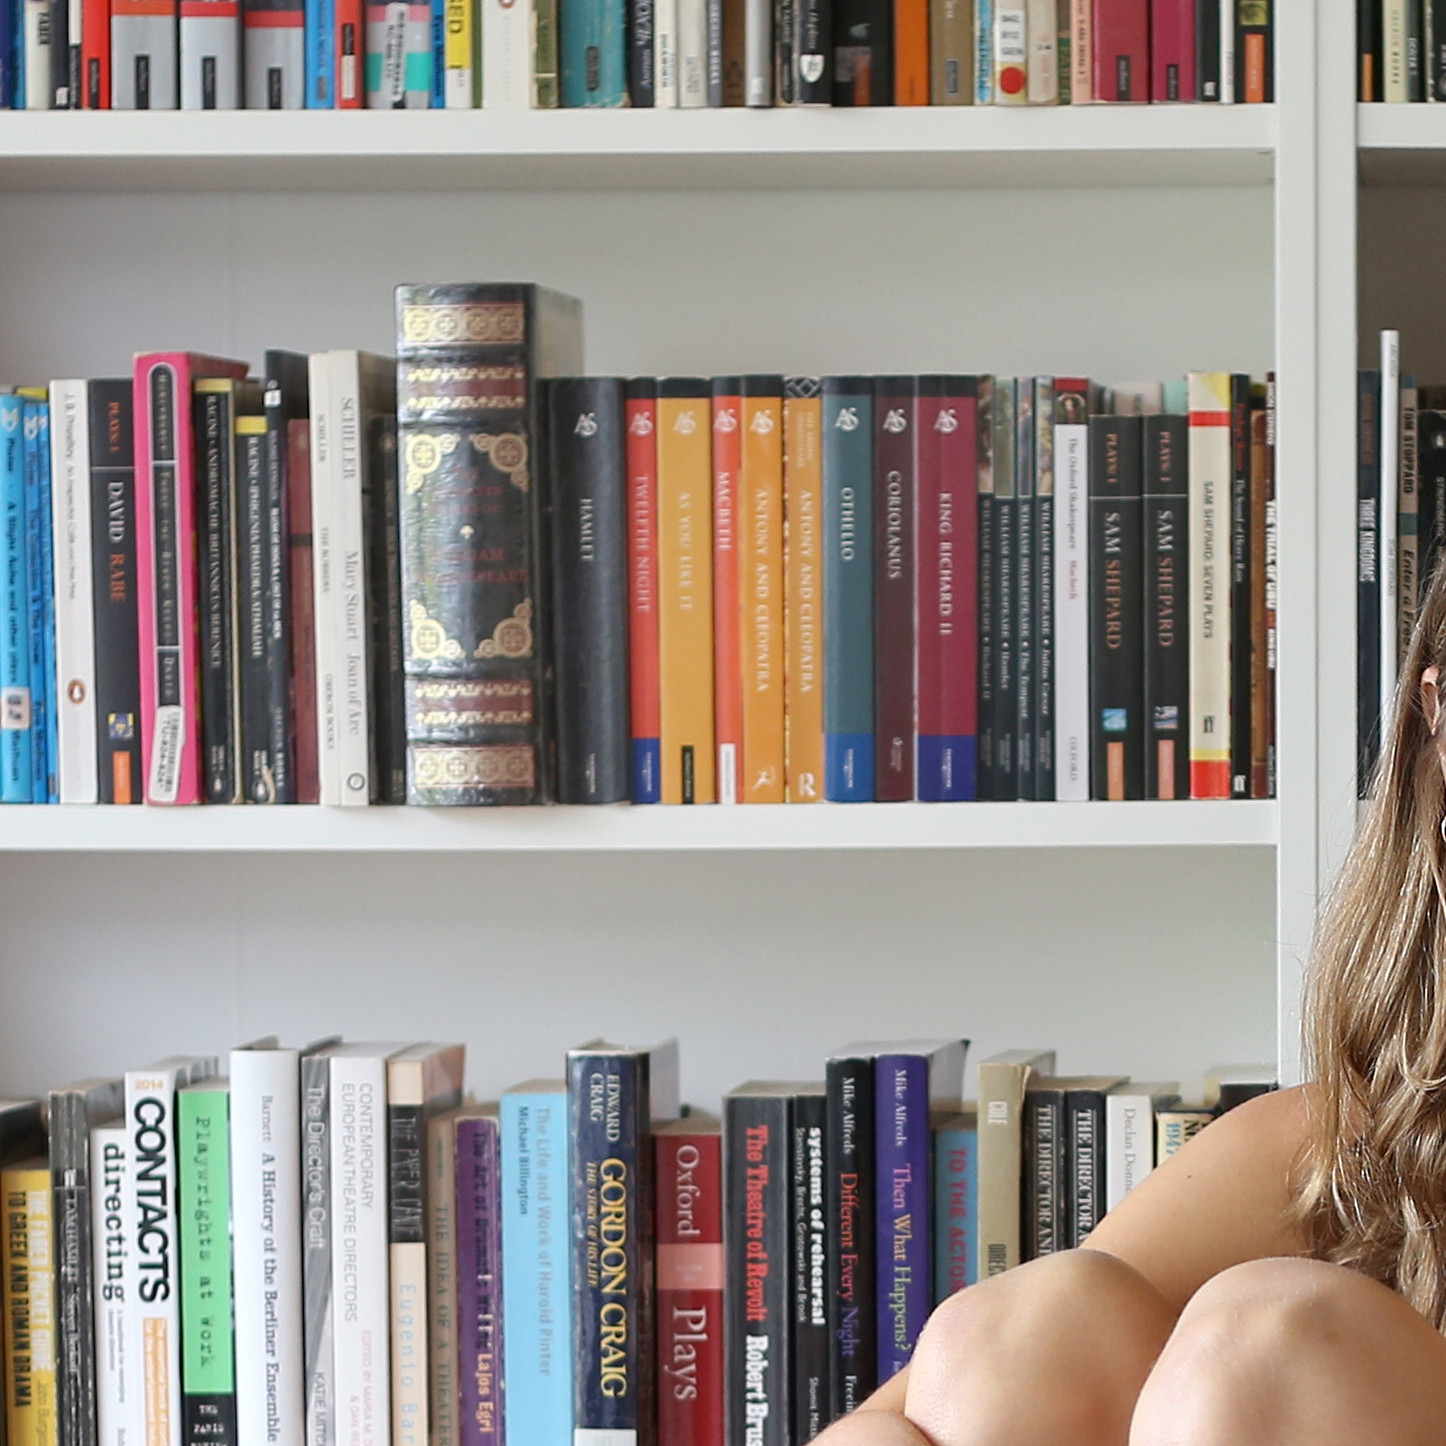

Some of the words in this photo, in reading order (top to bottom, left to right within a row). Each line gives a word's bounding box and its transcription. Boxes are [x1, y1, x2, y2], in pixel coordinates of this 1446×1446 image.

[341, 397, 356, 480] SCHILLER
[1403, 407, 1414, 432] TOM
[1403, 435, 1415, 494] STOPPARD
[108, 482, 124, 543] DAVID
[579, 498, 594, 562] HAMLET
[635, 474, 649, 551] TWELFTH
[717, 471, 731, 551] MACBETH
[755, 488, 769, 556] ANTONY
[840, 487, 855, 560] OTHELLO
[887, 470, 902, 579] CORIOLANUS
[938, 493, 952, 534] KING
[1157, 510, 1173, 551] SAM
[110, 553, 125, 603] RABE
[343, 551, 359, 591] Mary
[636, 556, 651, 613] NIGHT
[755, 562, 769, 598] AND
[938, 541, 952, 616] RICHARD
[346, 594, 360, 641] Stuart
[938, 622, 952, 635] II
[1157, 557, 1174, 647] SHEPARD
[347, 652, 360, 685] Joan
[755, 602, 770, 692] CLEOPATRA
[347, 687, 361, 705] of
[349, 707, 361, 735] Arc
[308, 1084, 325, 1117] The
[589, 1072, 604, 1122] CRAIG
[606, 1073, 620, 1142] EDWARD
[263, 1153, 276, 1164] A
[308, 1121, 325, 1202] Director's
[746, 1125, 767, 1161] The
[134, 1098, 169, 1303] CONTACTS
[195, 1116, 213, 1261] Playwrights
[260, 1170, 278, 1232] History
[676, 1144, 700, 1236] Oxford
[747, 1164, 767, 1237] Theatre
[839, 1172, 858, 1248] Different
[892, 1164, 910, 1209] Then
[101, 1144, 128, 1303] directing
[264, 1236, 278, 1255] of
[309, 1207, 325, 1248] Craft
[598, 1158, 626, 1295] GORDON
[747, 1241, 768, 1260] of
[893, 1214, 911, 1261] What
[200, 1276, 213, 1301] at
[264, 1259, 279, 1285] the
[747, 1263, 768, 1321] Revolt
[836, 1252, 859, 1302] Every
[265, 1290, 279, 1357] Berliner
[837, 1306, 860, 1356] Night
[889, 1265, 912, 1351] Happens?
[200, 1316, 215, 1367] Work
[599, 1303, 627, 1397] CRAIG
[665, 1306, 706, 1400] Plays
[746, 1334, 768, 1401] Robert
[266, 1362, 281, 1442] Ensemble
